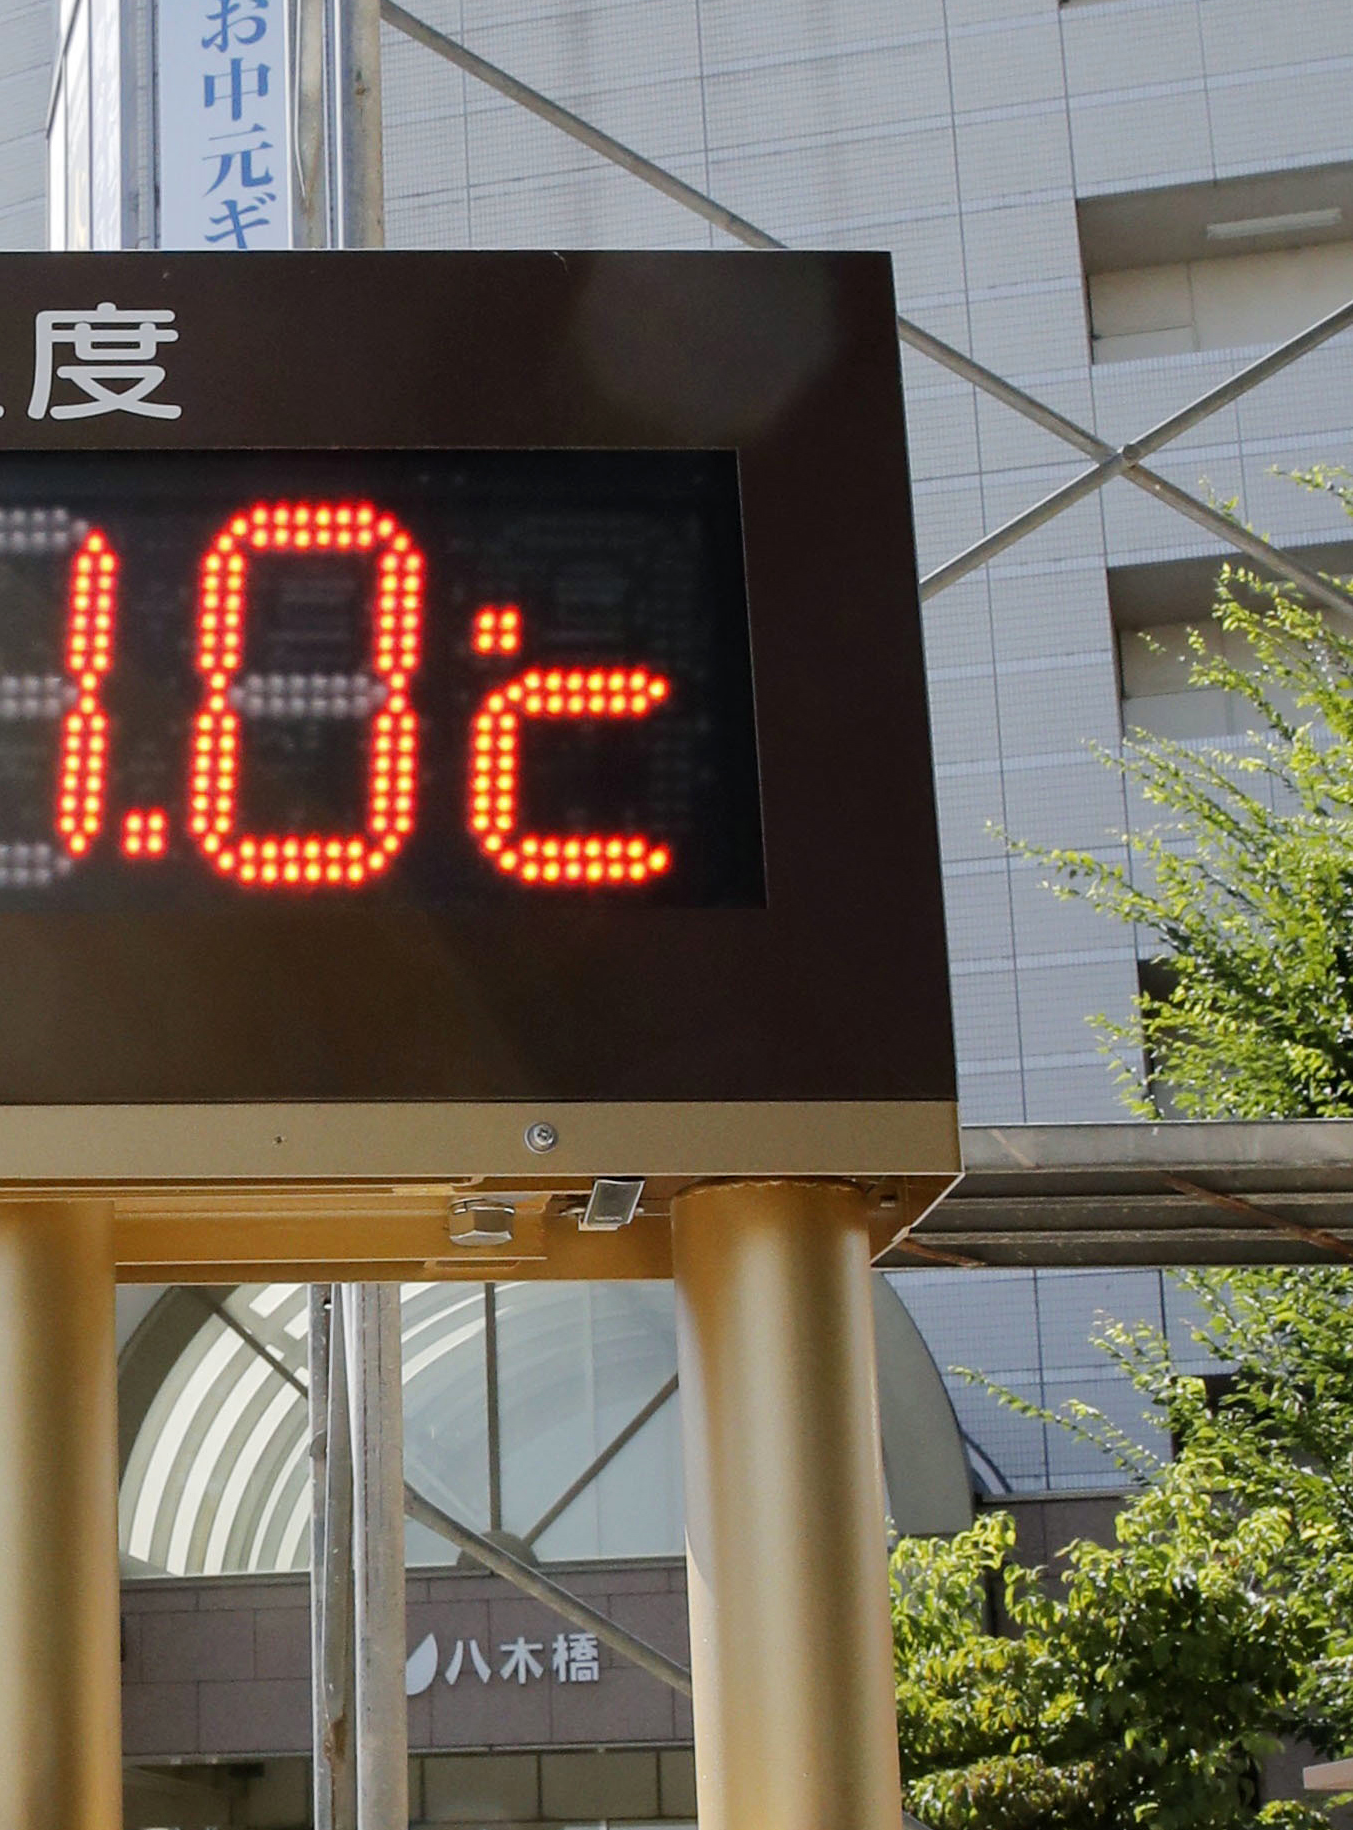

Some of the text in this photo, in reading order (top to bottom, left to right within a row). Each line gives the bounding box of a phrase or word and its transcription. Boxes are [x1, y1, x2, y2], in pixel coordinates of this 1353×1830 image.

[201, 0, 277, 249] お中元ギ
[445, 1632, 599, 1686] 八木橋
